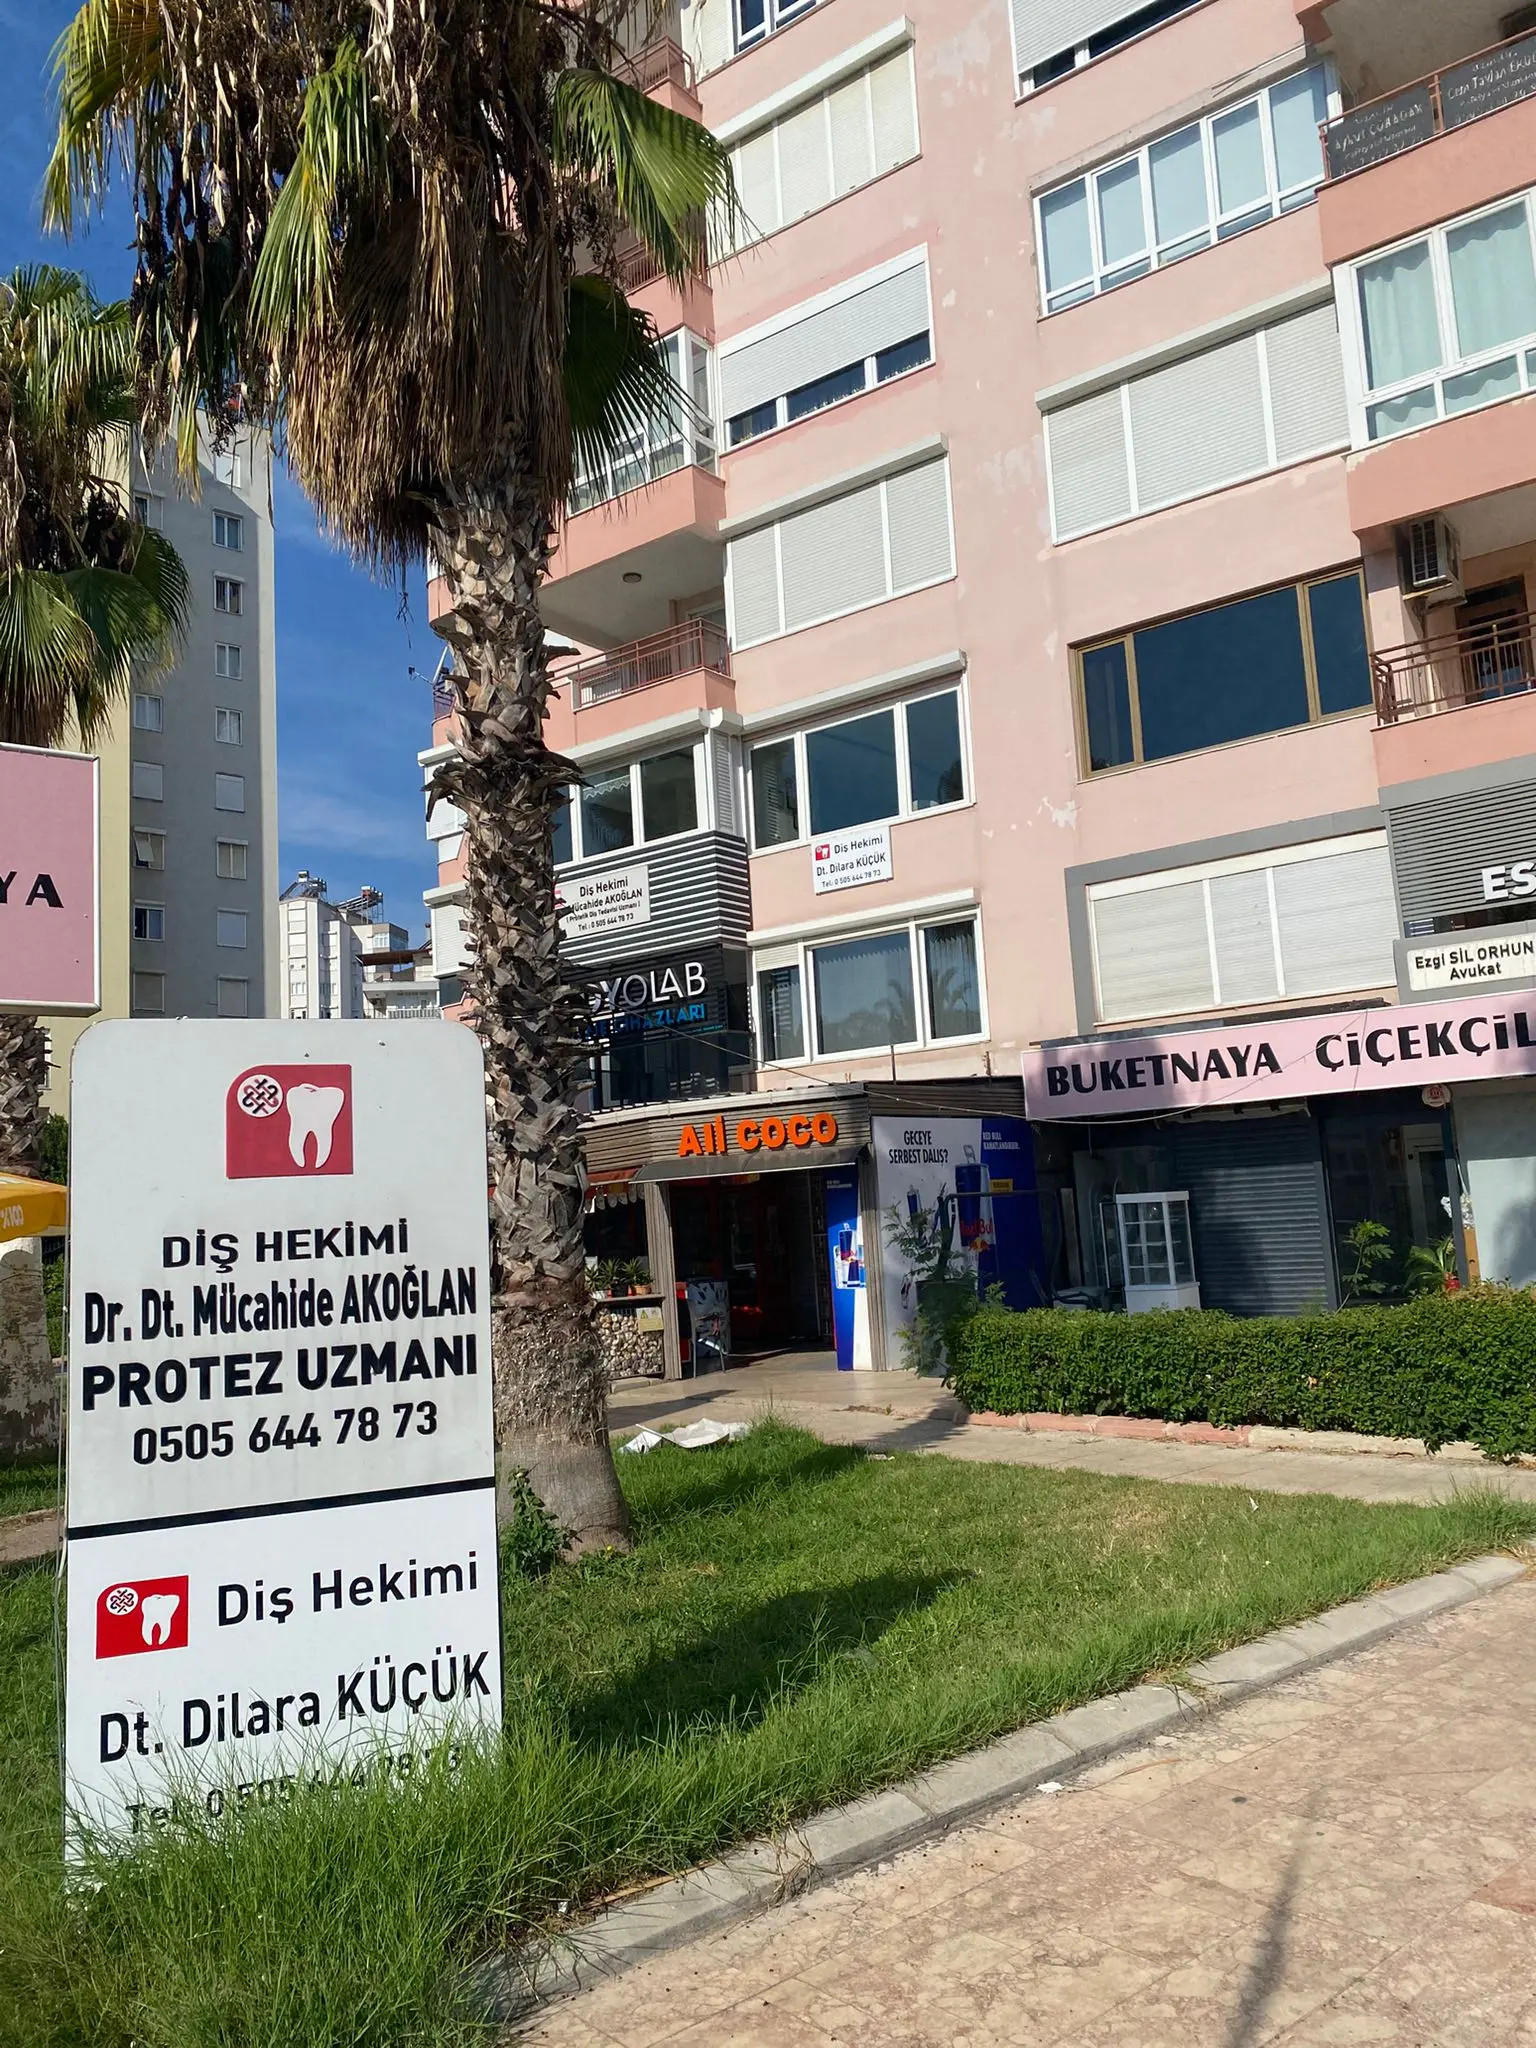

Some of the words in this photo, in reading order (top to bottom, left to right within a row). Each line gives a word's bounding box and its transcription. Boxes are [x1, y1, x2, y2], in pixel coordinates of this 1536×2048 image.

[834, 843, 849, 855] Diş
[850, 834, 883, 850] Hekimi
[816, 866, 828, 876] Dt.
[829, 861, 855, 874] Dilara
[856, 852, 886, 867] KÜÇÜK
[580, 885, 594, 897] Diş
[596, 876, 629, 893] Hekimi
[839, 876, 851, 884] 505
[864, 871, 872, 879] 78
[1482, 861, 1536, 900] ES
[571, 899, 604, 912] ücahide
[604, 888, 643, 905] AKOĞLAN
[596, 919, 606, 927] 505
[618, 914, 625, 922] 78
[626, 912, 634, 920] 73
[1415, 953, 1446, 969] Ezgi
[1449, 948, 1474, 964] SİL
[1477, 941, 1534, 961] ORHUN
[1450, 963, 1503, 981] Avukat
[1047, 1042, 1283, 1097] BUKETNAYA
[903, 1130, 932, 1145] GECEYE
[889, 1149, 922, 1164] SERBEST
[922, 1149, 949, 1166] DALIŞ?
[162, 1229, 239, 1273] DİŞ
[255, 1218, 409, 1262] HEKİMİ
[84, 1292, 132, 1345] Dr.
[142, 1286, 183, 1340] Dt.
[193, 1277, 334, 1337] Mücahide
[341, 1264, 477, 1325] AKOĞLAN
[82, 1350, 283, 1411] PROTEZ
[298, 1334, 478, 1391] UZMANI
[133, 1420, 234, 1465] 0505
[249, 1413, 321, 1453] 644
[334, 1406, 379, 1444] 78
[393, 1401, 438, 1438] 73
[217, 1579, 294, 1626] Diş
[312, 1551, 478, 1613] Hekimi
[100, 1711, 162, 1763] Dt.
[183, 1692, 321, 1749] Dilara
[337, 1645, 490, 1720] KÜÇÜK
